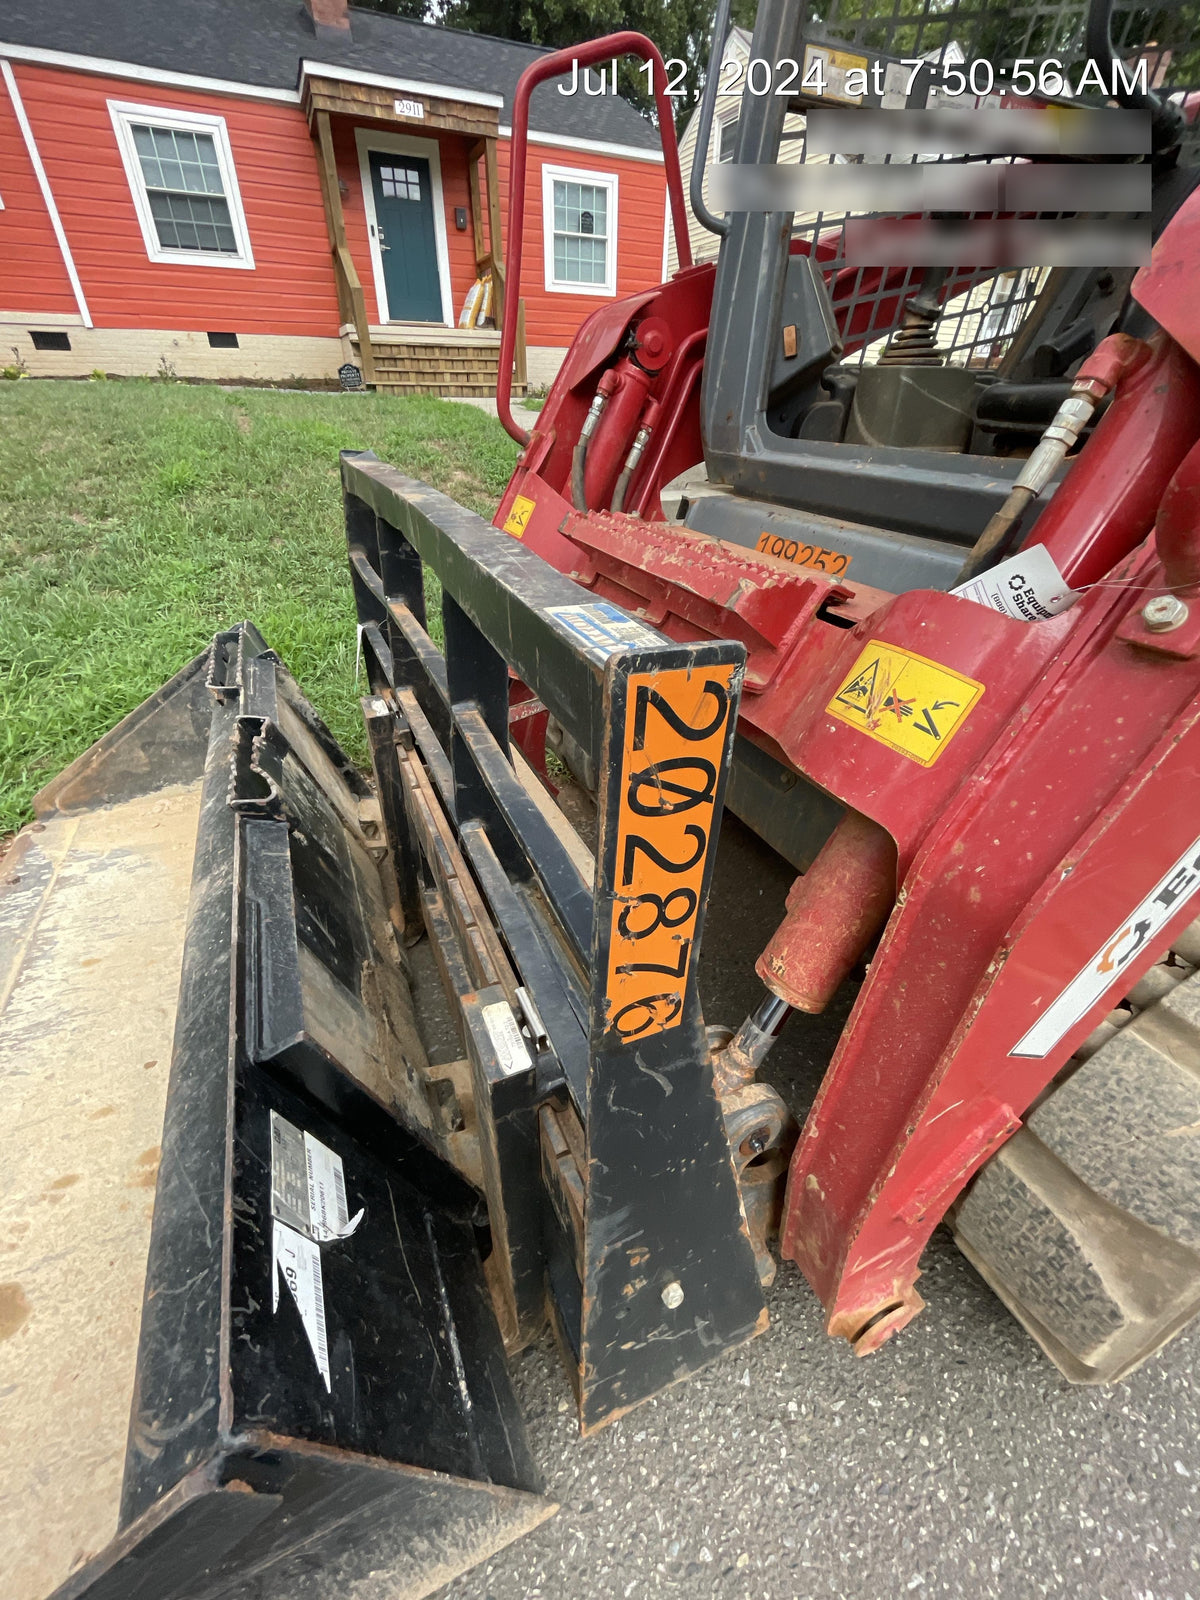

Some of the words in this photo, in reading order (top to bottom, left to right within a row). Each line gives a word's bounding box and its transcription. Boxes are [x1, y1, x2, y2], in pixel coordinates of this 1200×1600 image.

[398, 101, 420, 116] 2911
[760, 534, 848, 575] 199252
[1012, 593, 1037, 621] Share
[612, 679, 729, 1038] 202876
[306, 1148, 314, 1181] NUMBER
[308, 1183, 317, 1212] SERIAL
[285, 1266, 299, 1304] 69
